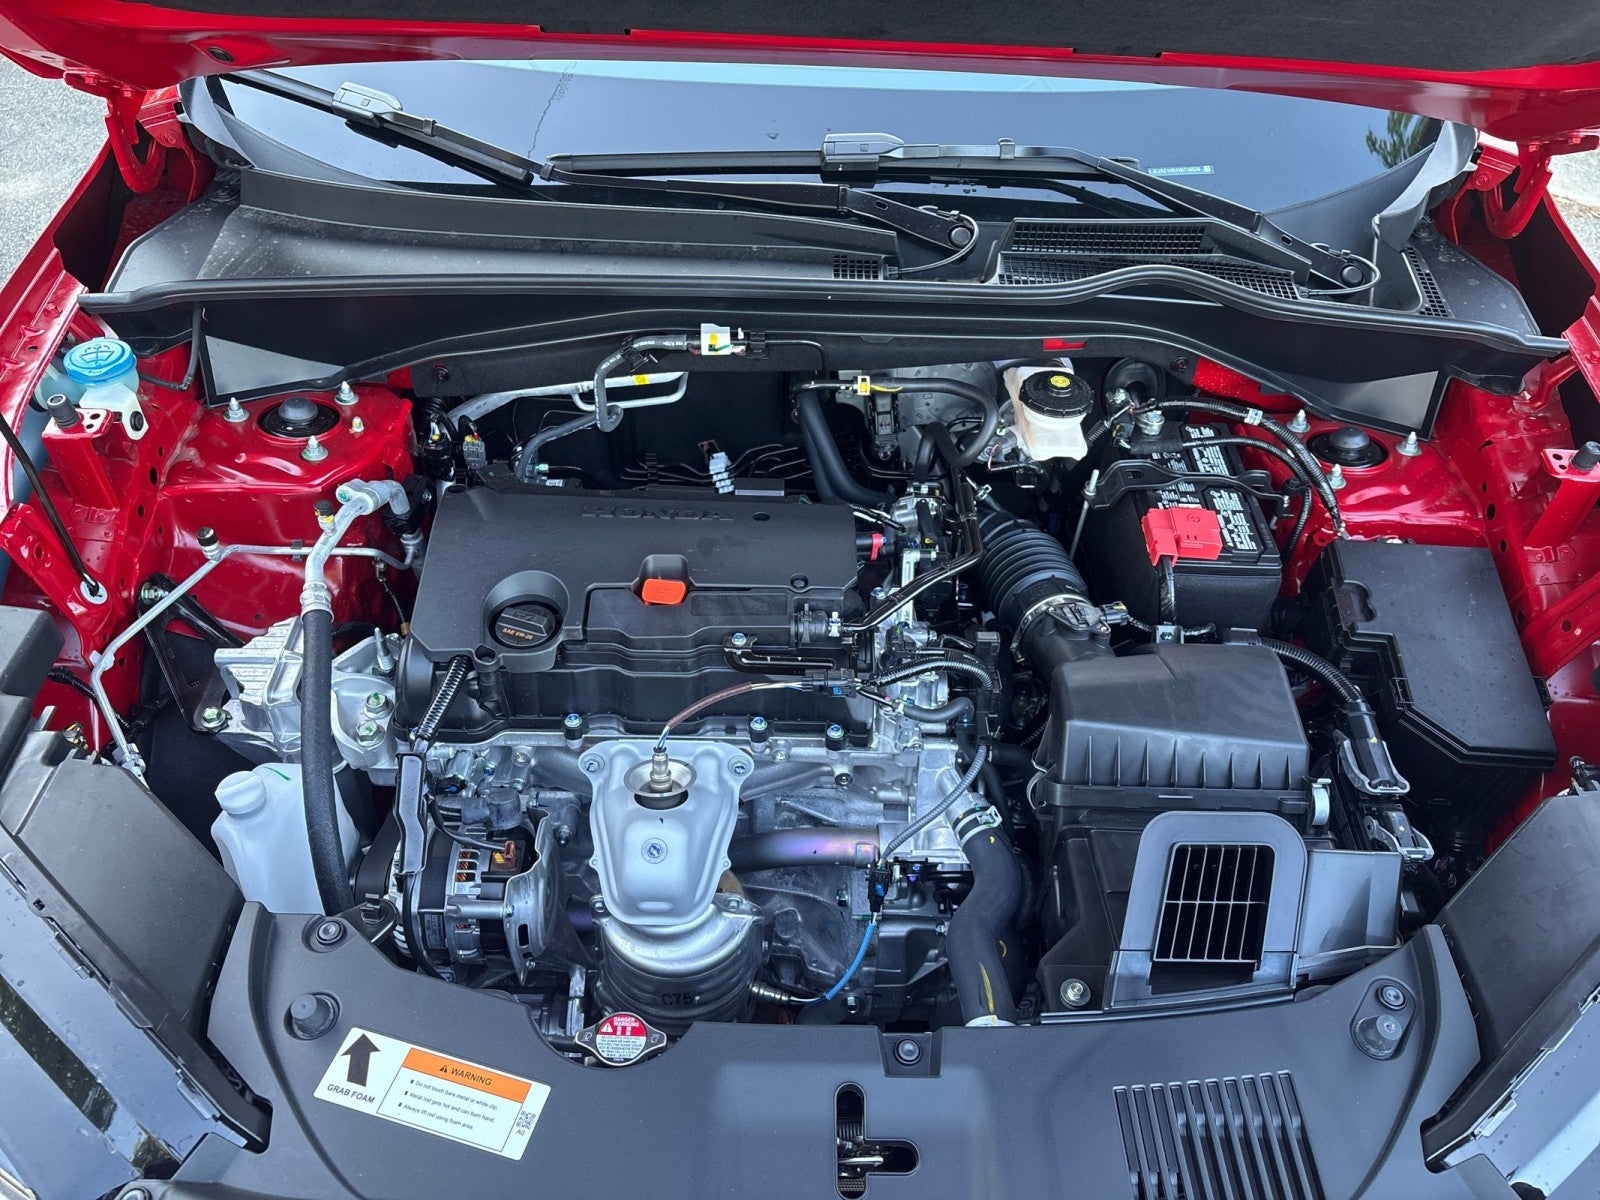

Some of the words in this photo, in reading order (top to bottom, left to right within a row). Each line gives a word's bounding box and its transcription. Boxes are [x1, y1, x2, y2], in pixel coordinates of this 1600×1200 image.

[581, 506, 735, 521] HONDA
[502, 627, 516, 636] SAE
[450, 1067, 493, 1086] WARNING
[327, 1083, 351, 1097] GRAB
[350, 1090, 376, 1104] FOAM
[409, 1092, 423, 1100] Metal
[402, 1104, 420, 1113] Always
[436, 1115, 449, 1123] using
